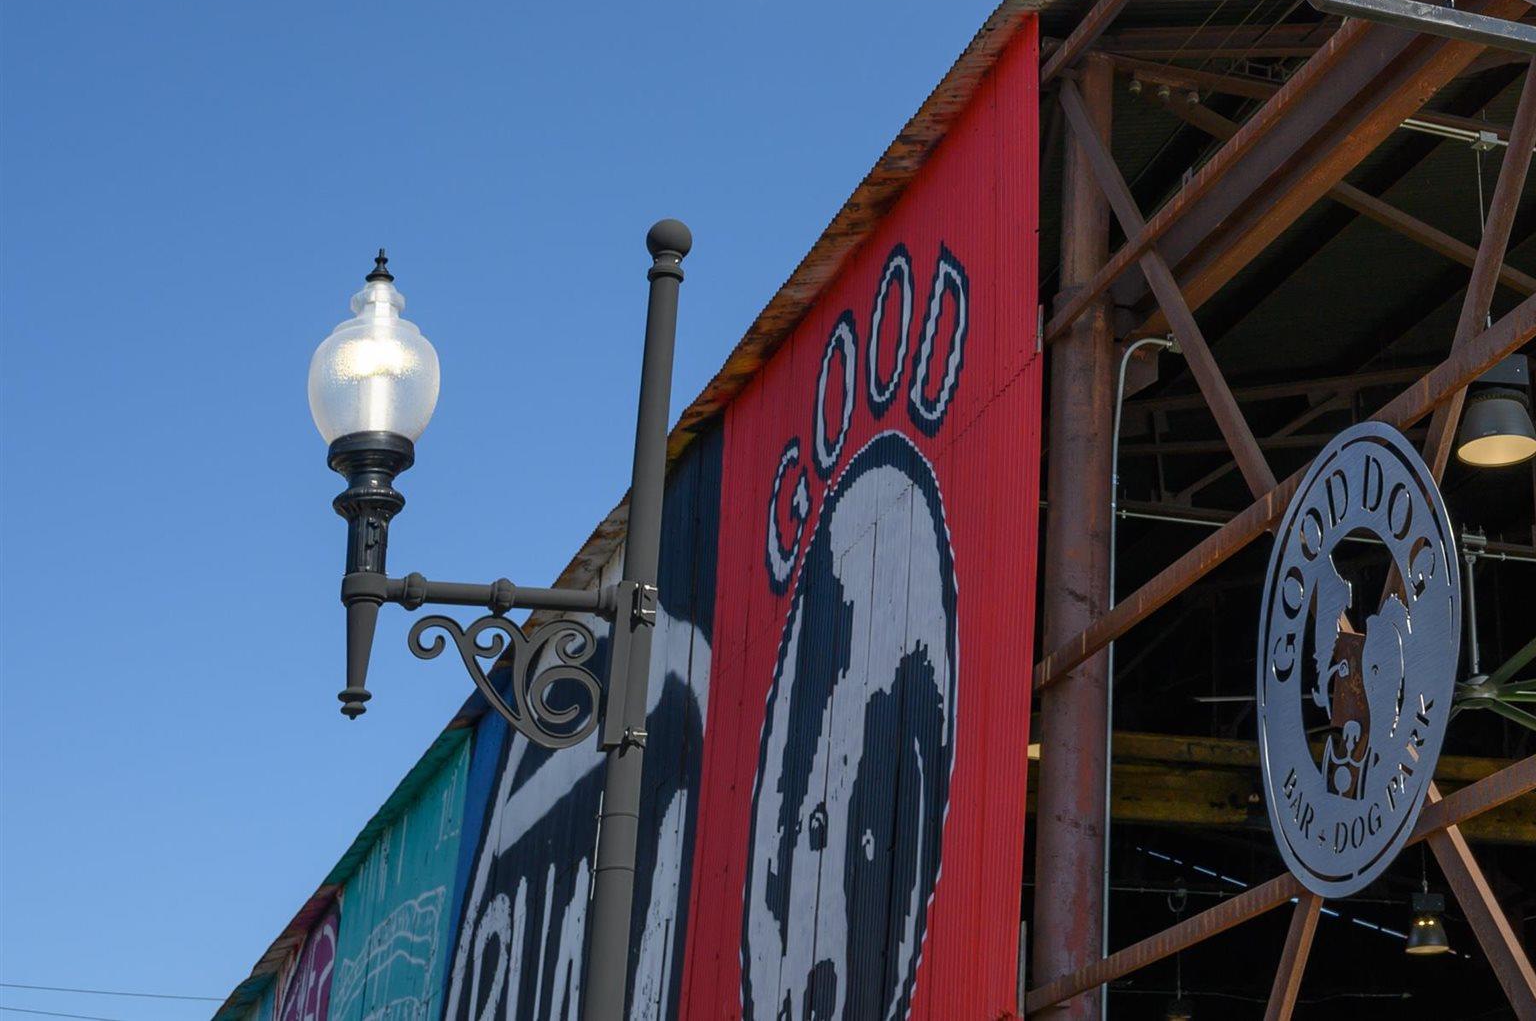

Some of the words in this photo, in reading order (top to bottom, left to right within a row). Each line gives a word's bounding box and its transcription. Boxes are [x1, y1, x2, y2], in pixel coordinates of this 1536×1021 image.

[765, 240, 969, 596] GOOD
[1272, 468, 1349, 683] GOOD
[1362, 454, 1436, 601] DOG
[1282, 767, 1315, 840] BAR
[1333, 801, 1382, 854] DOG
[1387, 693, 1434, 812] PARK
